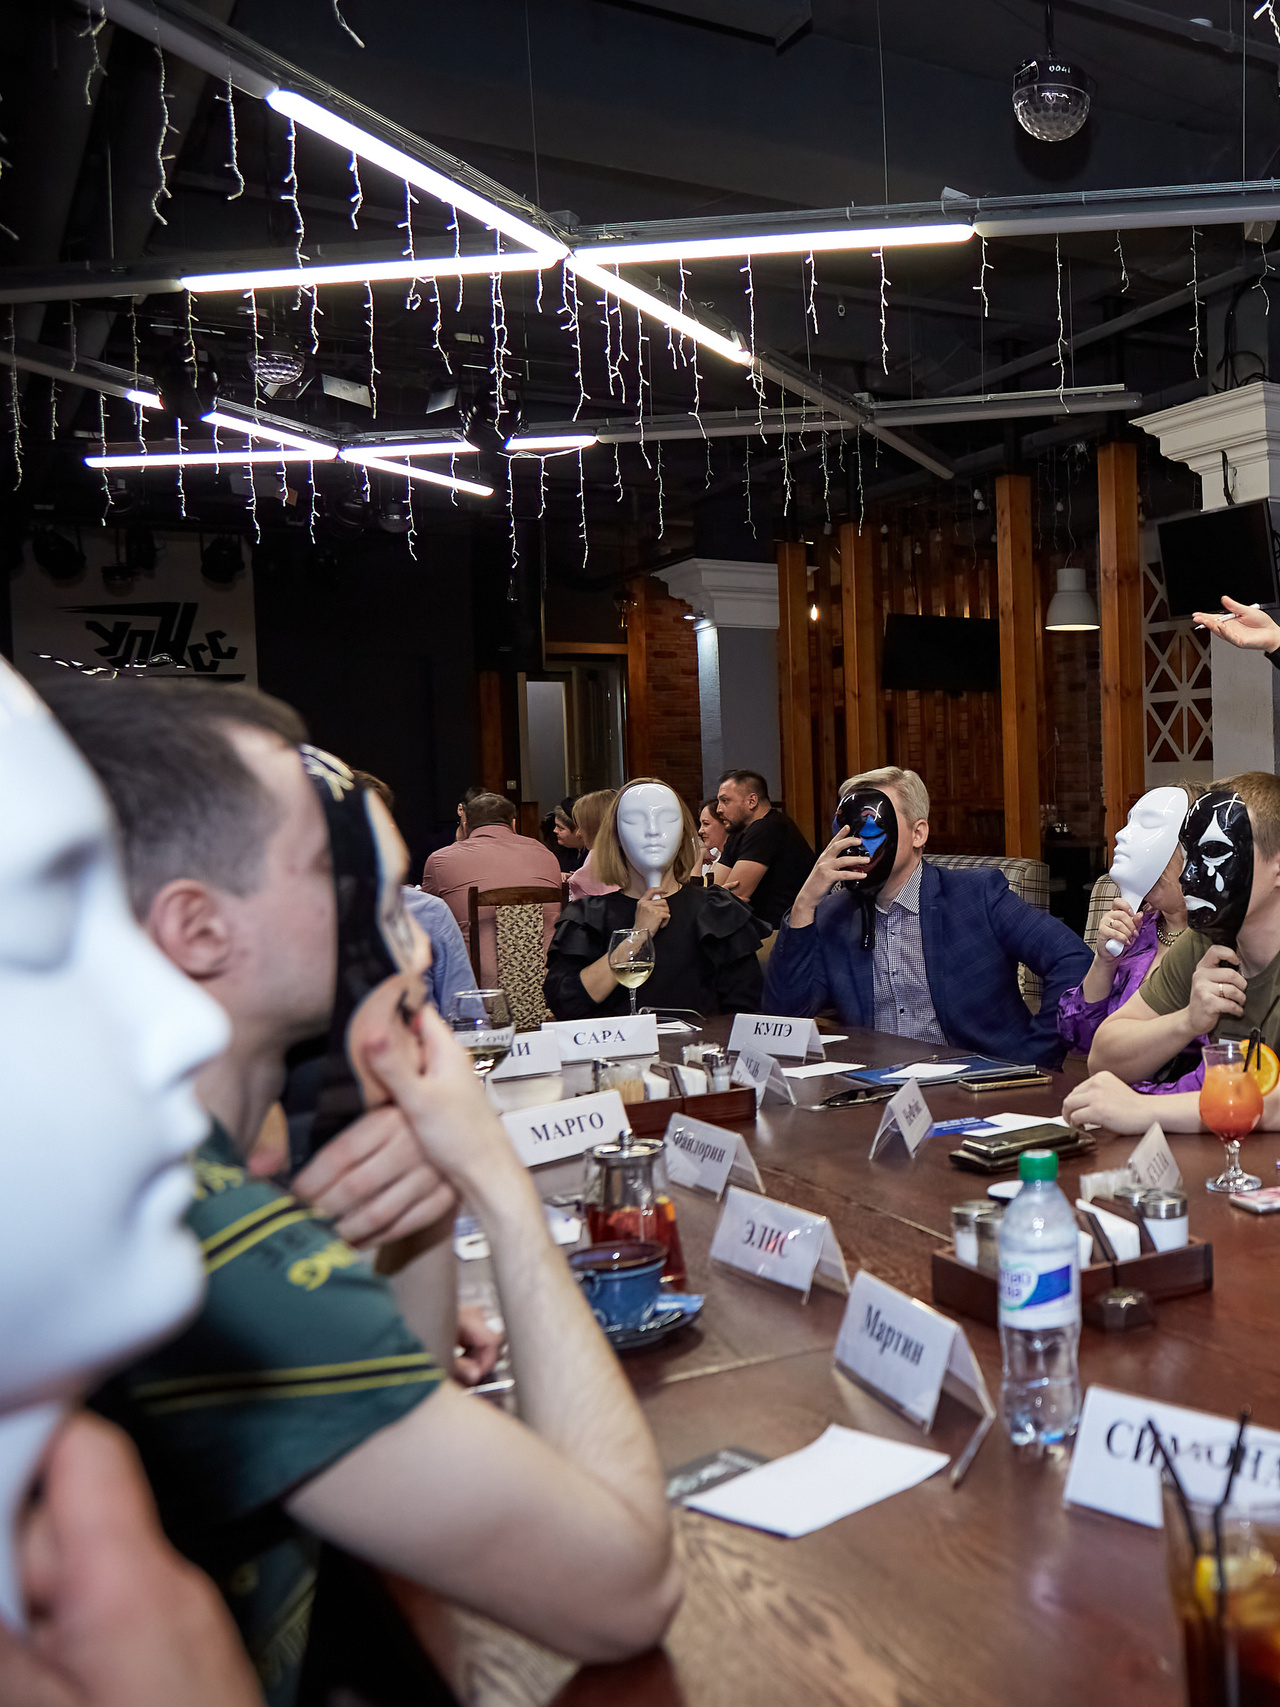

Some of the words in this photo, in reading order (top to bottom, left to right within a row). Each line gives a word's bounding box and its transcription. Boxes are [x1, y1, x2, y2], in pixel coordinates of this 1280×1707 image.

[573, 1029, 626, 1046] САРА
[753, 1021, 793, 1037] КУПЭ
[530, 1112, 604, 1144] МАРГО
[742, 1219, 795, 1258] ЭЛИС
[863, 1304, 925, 1366] Мартин
